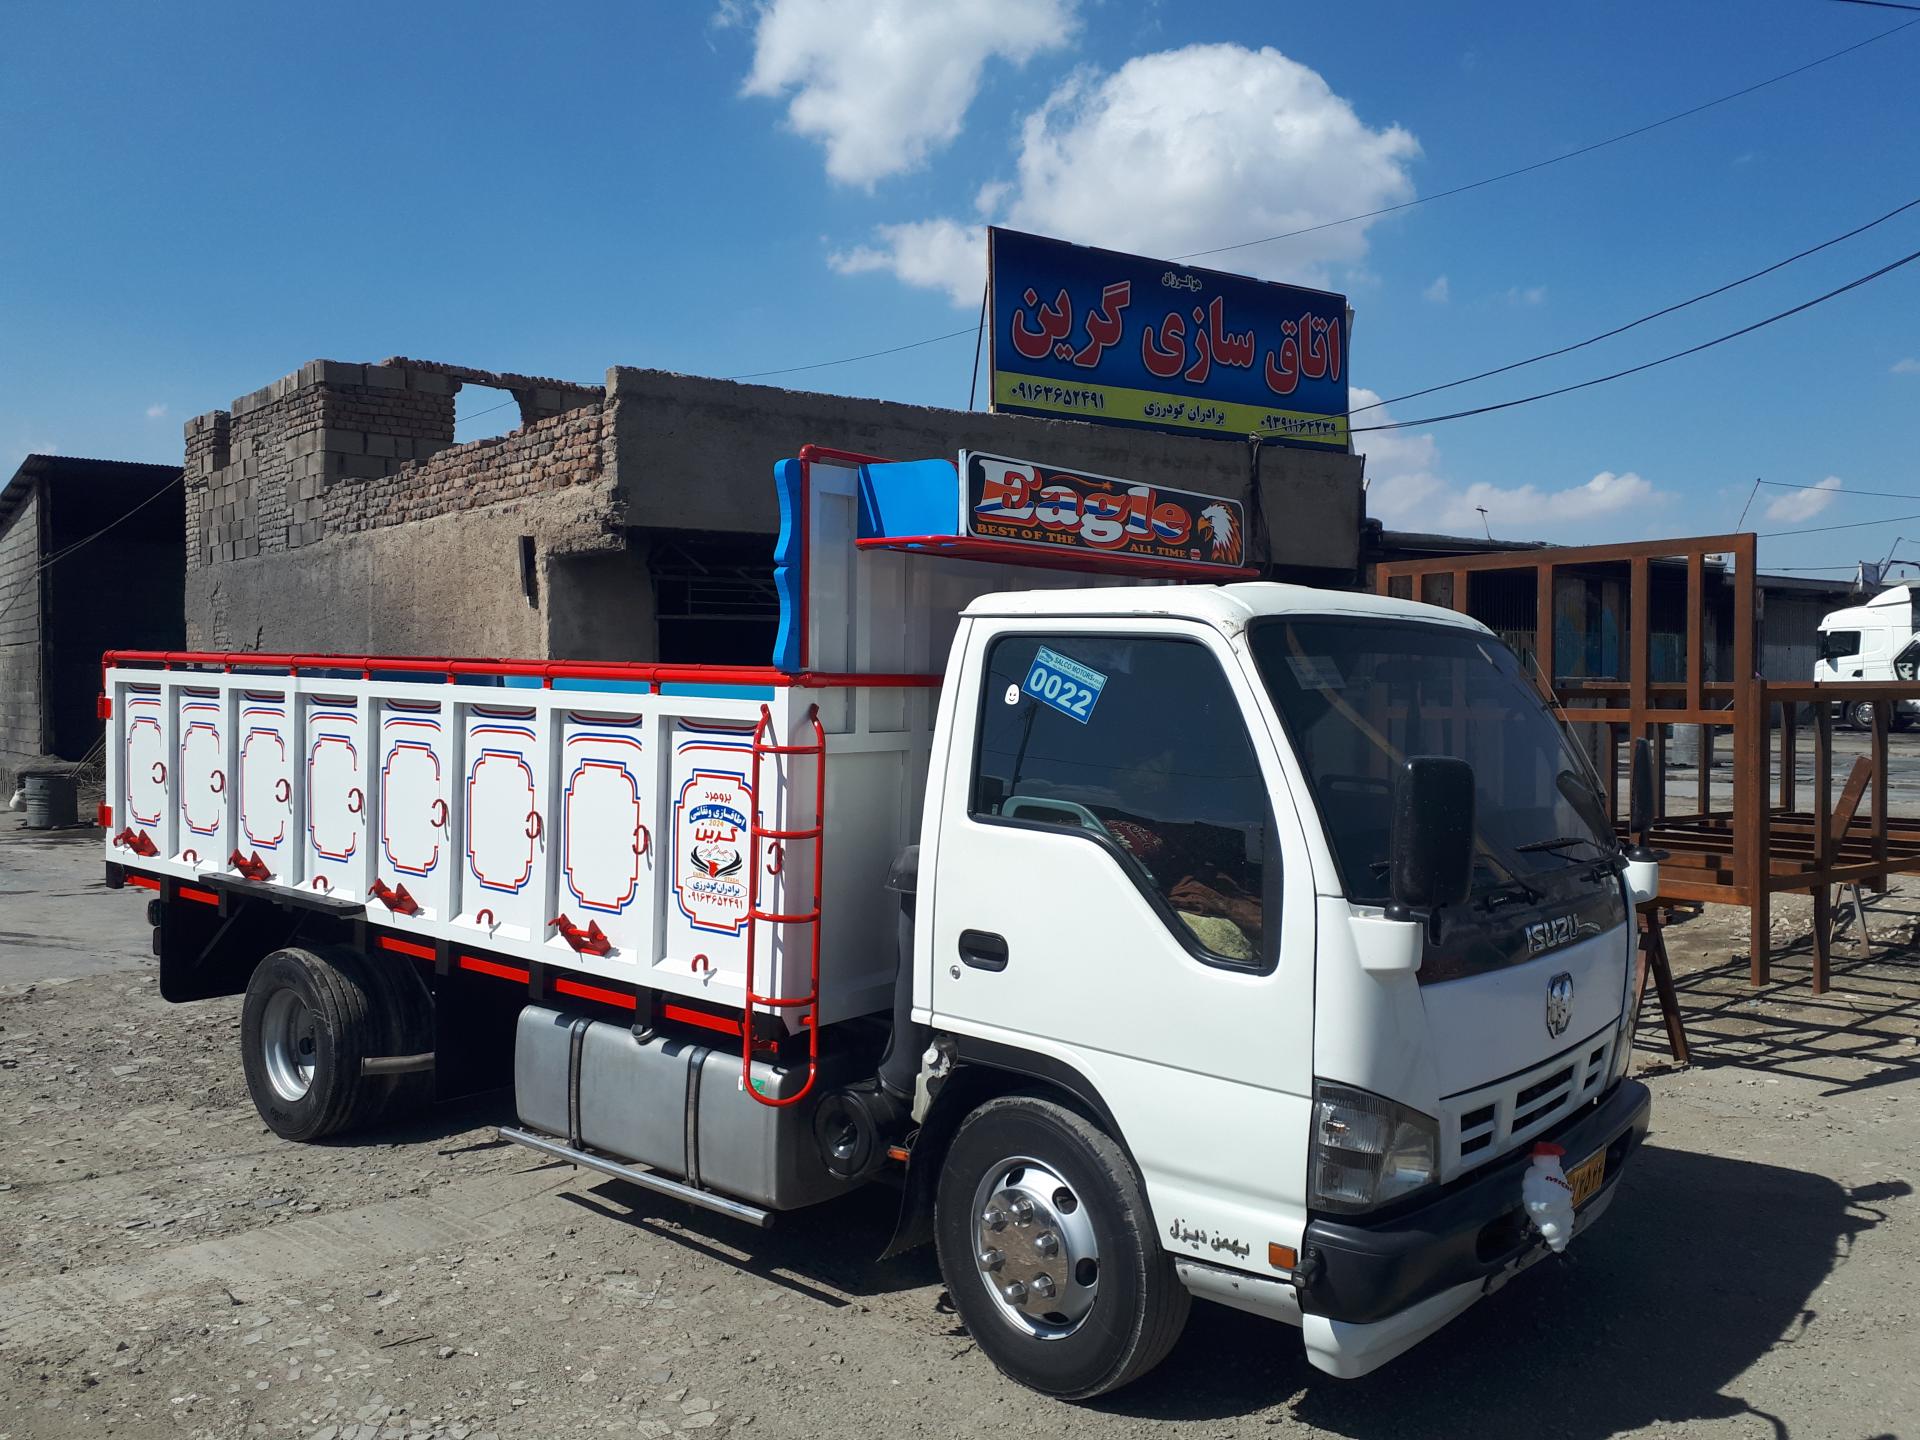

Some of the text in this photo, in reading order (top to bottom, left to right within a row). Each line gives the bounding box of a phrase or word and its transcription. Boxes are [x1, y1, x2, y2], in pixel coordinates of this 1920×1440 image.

[1012, 280, 1340, 394] اتاق سازی گرین
[1143, 401, 1226, 425] برادران گودرزی
[974, 458, 1192, 550] Eagle
[976, 523, 1017, 539] BEST
[1021, 527, 1042, 541] OF
[1046, 531, 1077, 545] THE
[1129, 543, 1155, 556] ALL
[1156, 546, 1187, 559] TIME
[1029, 667, 1092, 716] 0022
[704, 791, 732, 804] بروجرد
[695, 822, 738, 844] گرین
[692, 880, 740, 897] برادران گودرزی
[1525, 913, 1580, 953] ISUZU
[1169, 1218, 1250, 1260] بهمن دیزل
